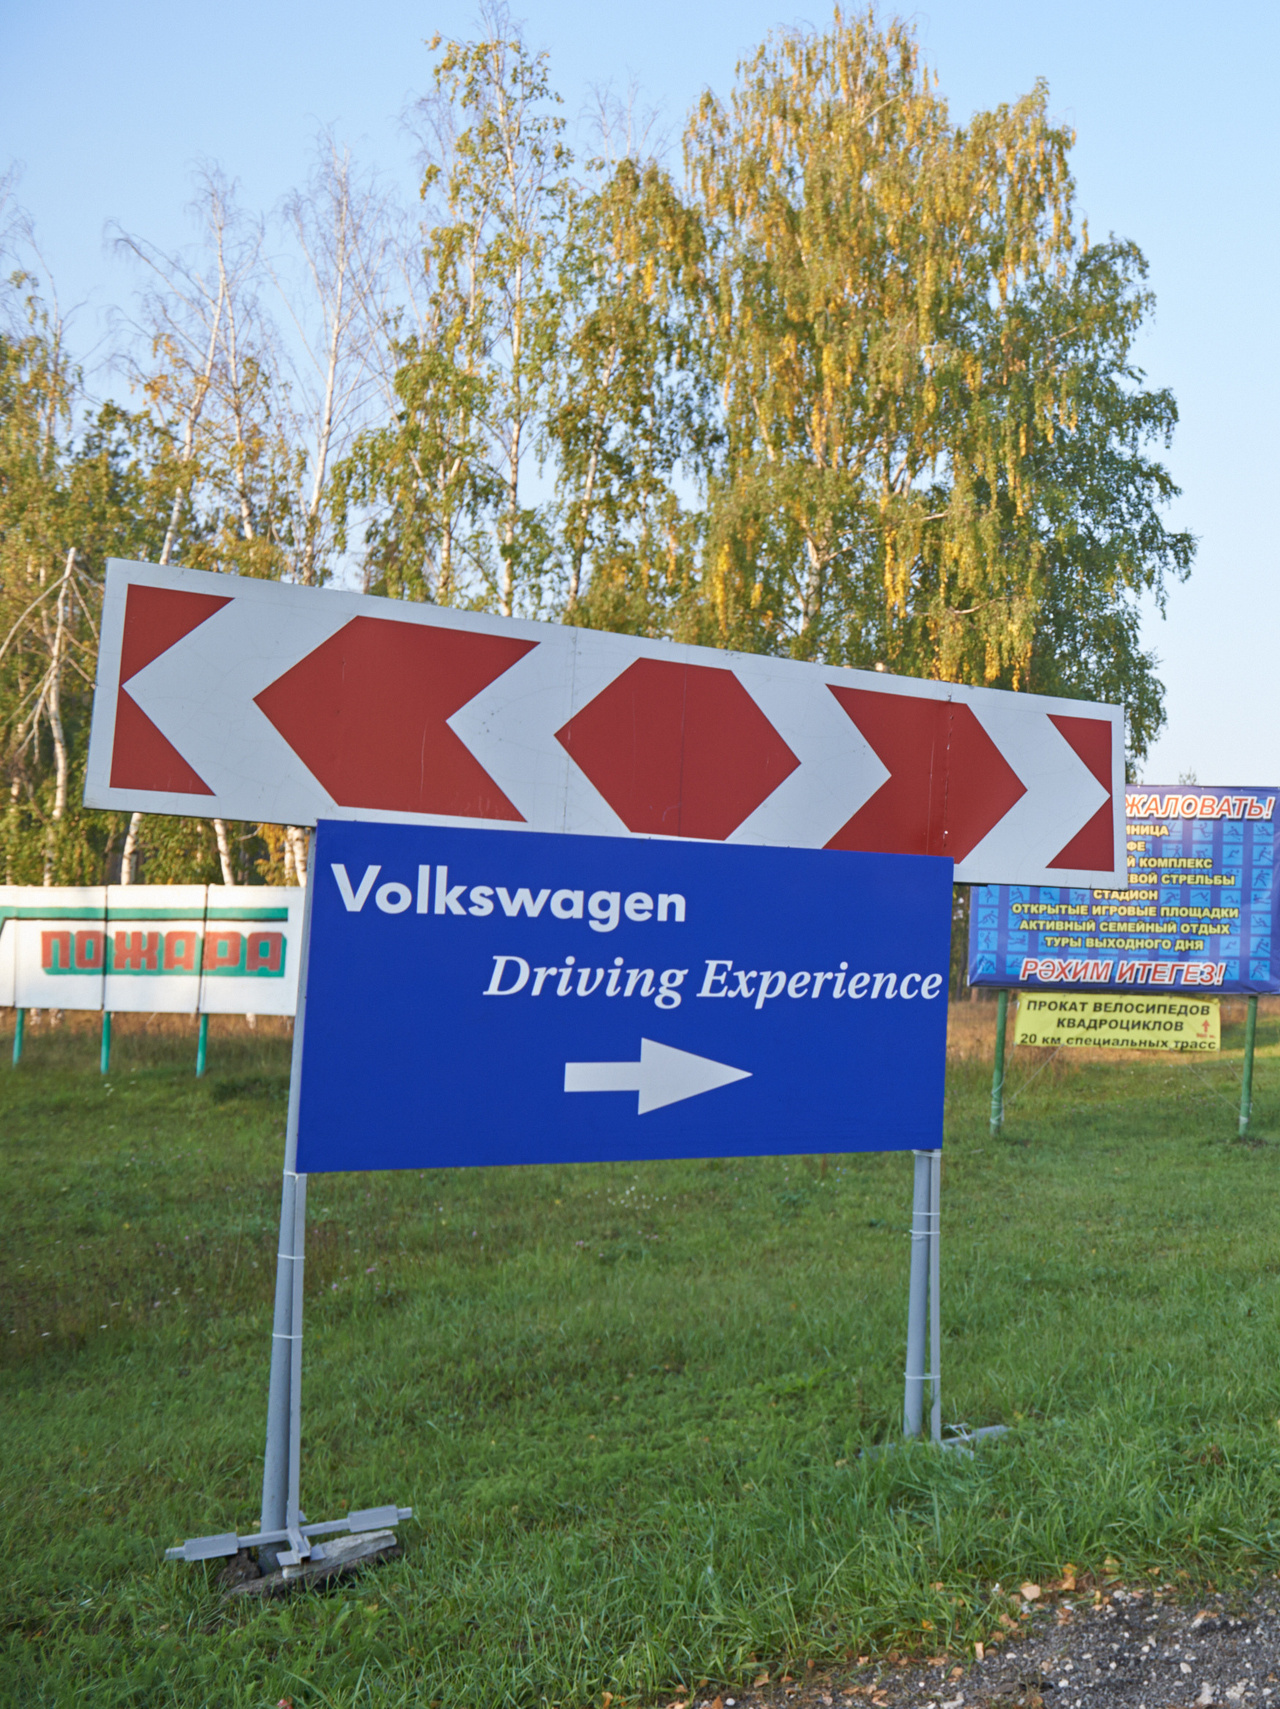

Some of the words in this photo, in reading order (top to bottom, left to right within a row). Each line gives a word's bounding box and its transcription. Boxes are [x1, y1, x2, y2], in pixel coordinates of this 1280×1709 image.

[1126, 794, 1275, 819] ЖАЛОВАТЬ!
[1139, 858, 1213, 869] КОМПЛЕКС
[1127, 872, 1158, 884] ВОЙ
[1161, 874, 1235, 886] СТРЕЛЬБЫ
[331, 863, 686, 932] Volkswagen
[1093, 889, 1159, 902] СТАДИОН
[1012, 903, 1089, 916] ОТКРЫТЫЕ
[1091, 905, 1157, 917] ИГРОВЫЕ
[1160, 907, 1239, 919] ПЛОЩАДКИ
[1019, 919, 1096, 933] АКТИВНЫЙ
[1099, 920, 1177, 934] СЕМЕЙНЫЙ
[1180, 924, 1230, 936] ОТДЫХ
[1045, 936, 1082, 948] ТУРЫ
[1085, 938, 1172, 951] ВЫХОДНОГО
[1174, 940, 1204, 952] ДНЯ
[41, 931, 287, 977] ПОЖАРА
[1019, 958, 1113, 983] РӘХИМ
[1115, 961, 1227, 986] ИТЕГЕЗ!
[483, 955, 688, 1009] Driving
[696, 960, 943, 1009] Experience
[1026, 1000, 1088, 1012] ПРОКАТ
[1093, 1002, 1210, 1016] ВЕЛОСИПЕДОВ
[1056, 1018, 1184, 1032] КВАДРОЦИКЛОВ
[1020, 1033, 1038, 1045] 20
[1042, 1036, 1062, 1045] км
[1066, 1036, 1168, 1049] специальных
[1174, 1040, 1216, 1051] трасс
